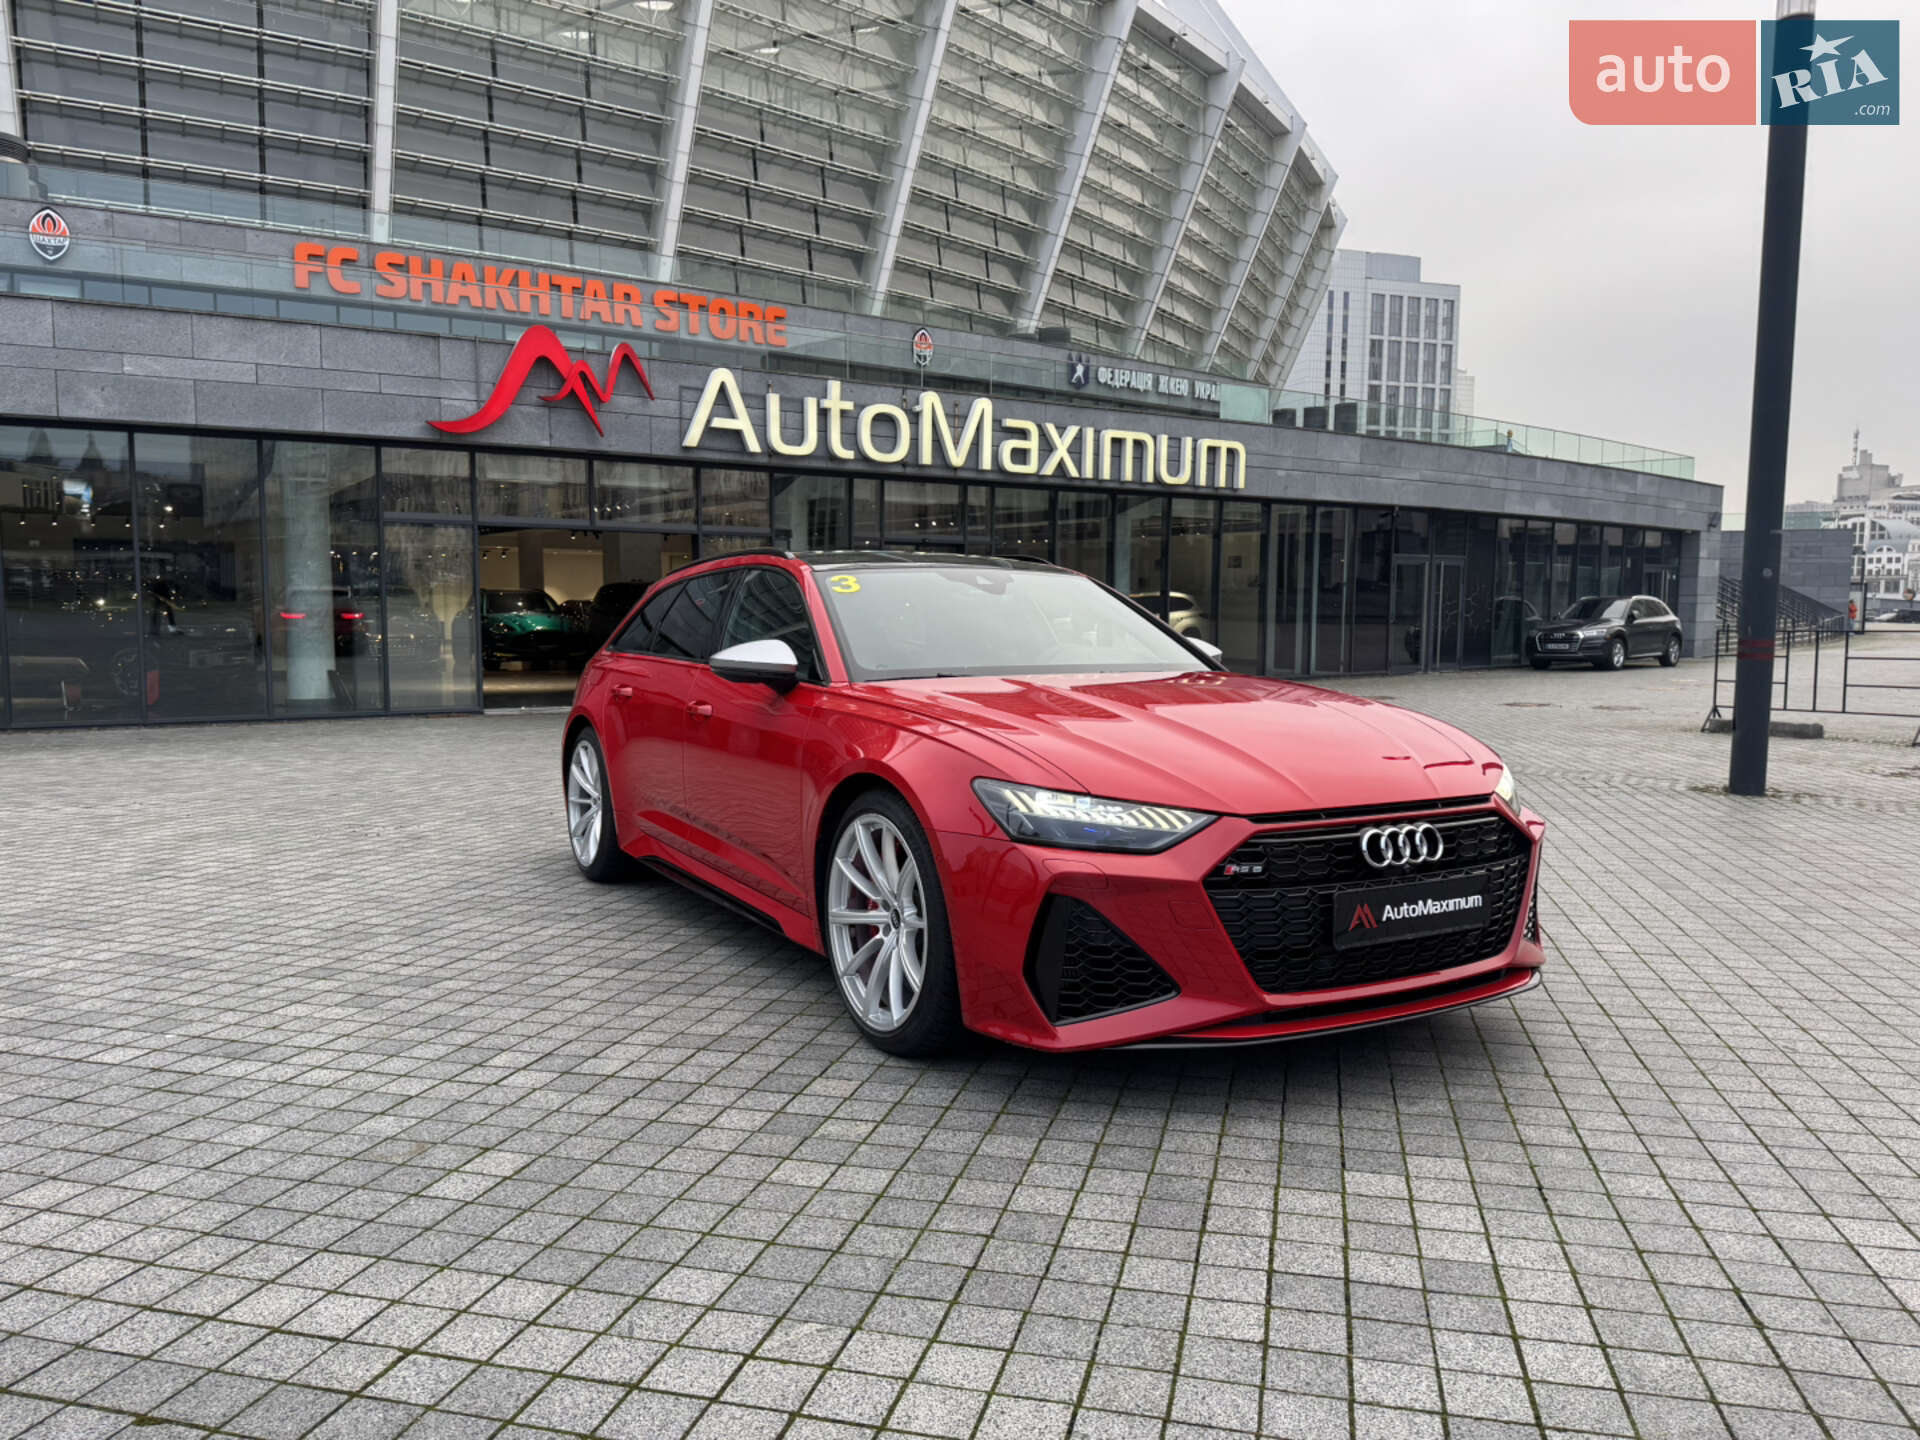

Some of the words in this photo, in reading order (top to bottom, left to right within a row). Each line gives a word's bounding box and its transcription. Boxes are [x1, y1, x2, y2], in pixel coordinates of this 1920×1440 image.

[293, 242, 361, 294] FC
[374, 251, 643, 327] SHAKHTAR
[653, 290, 787, 347] STORE
[682, 367, 1247, 489] AutoMaximum
[830, 575, 861, 593] 3
[1382, 893, 1483, 922] AutoMaximum
